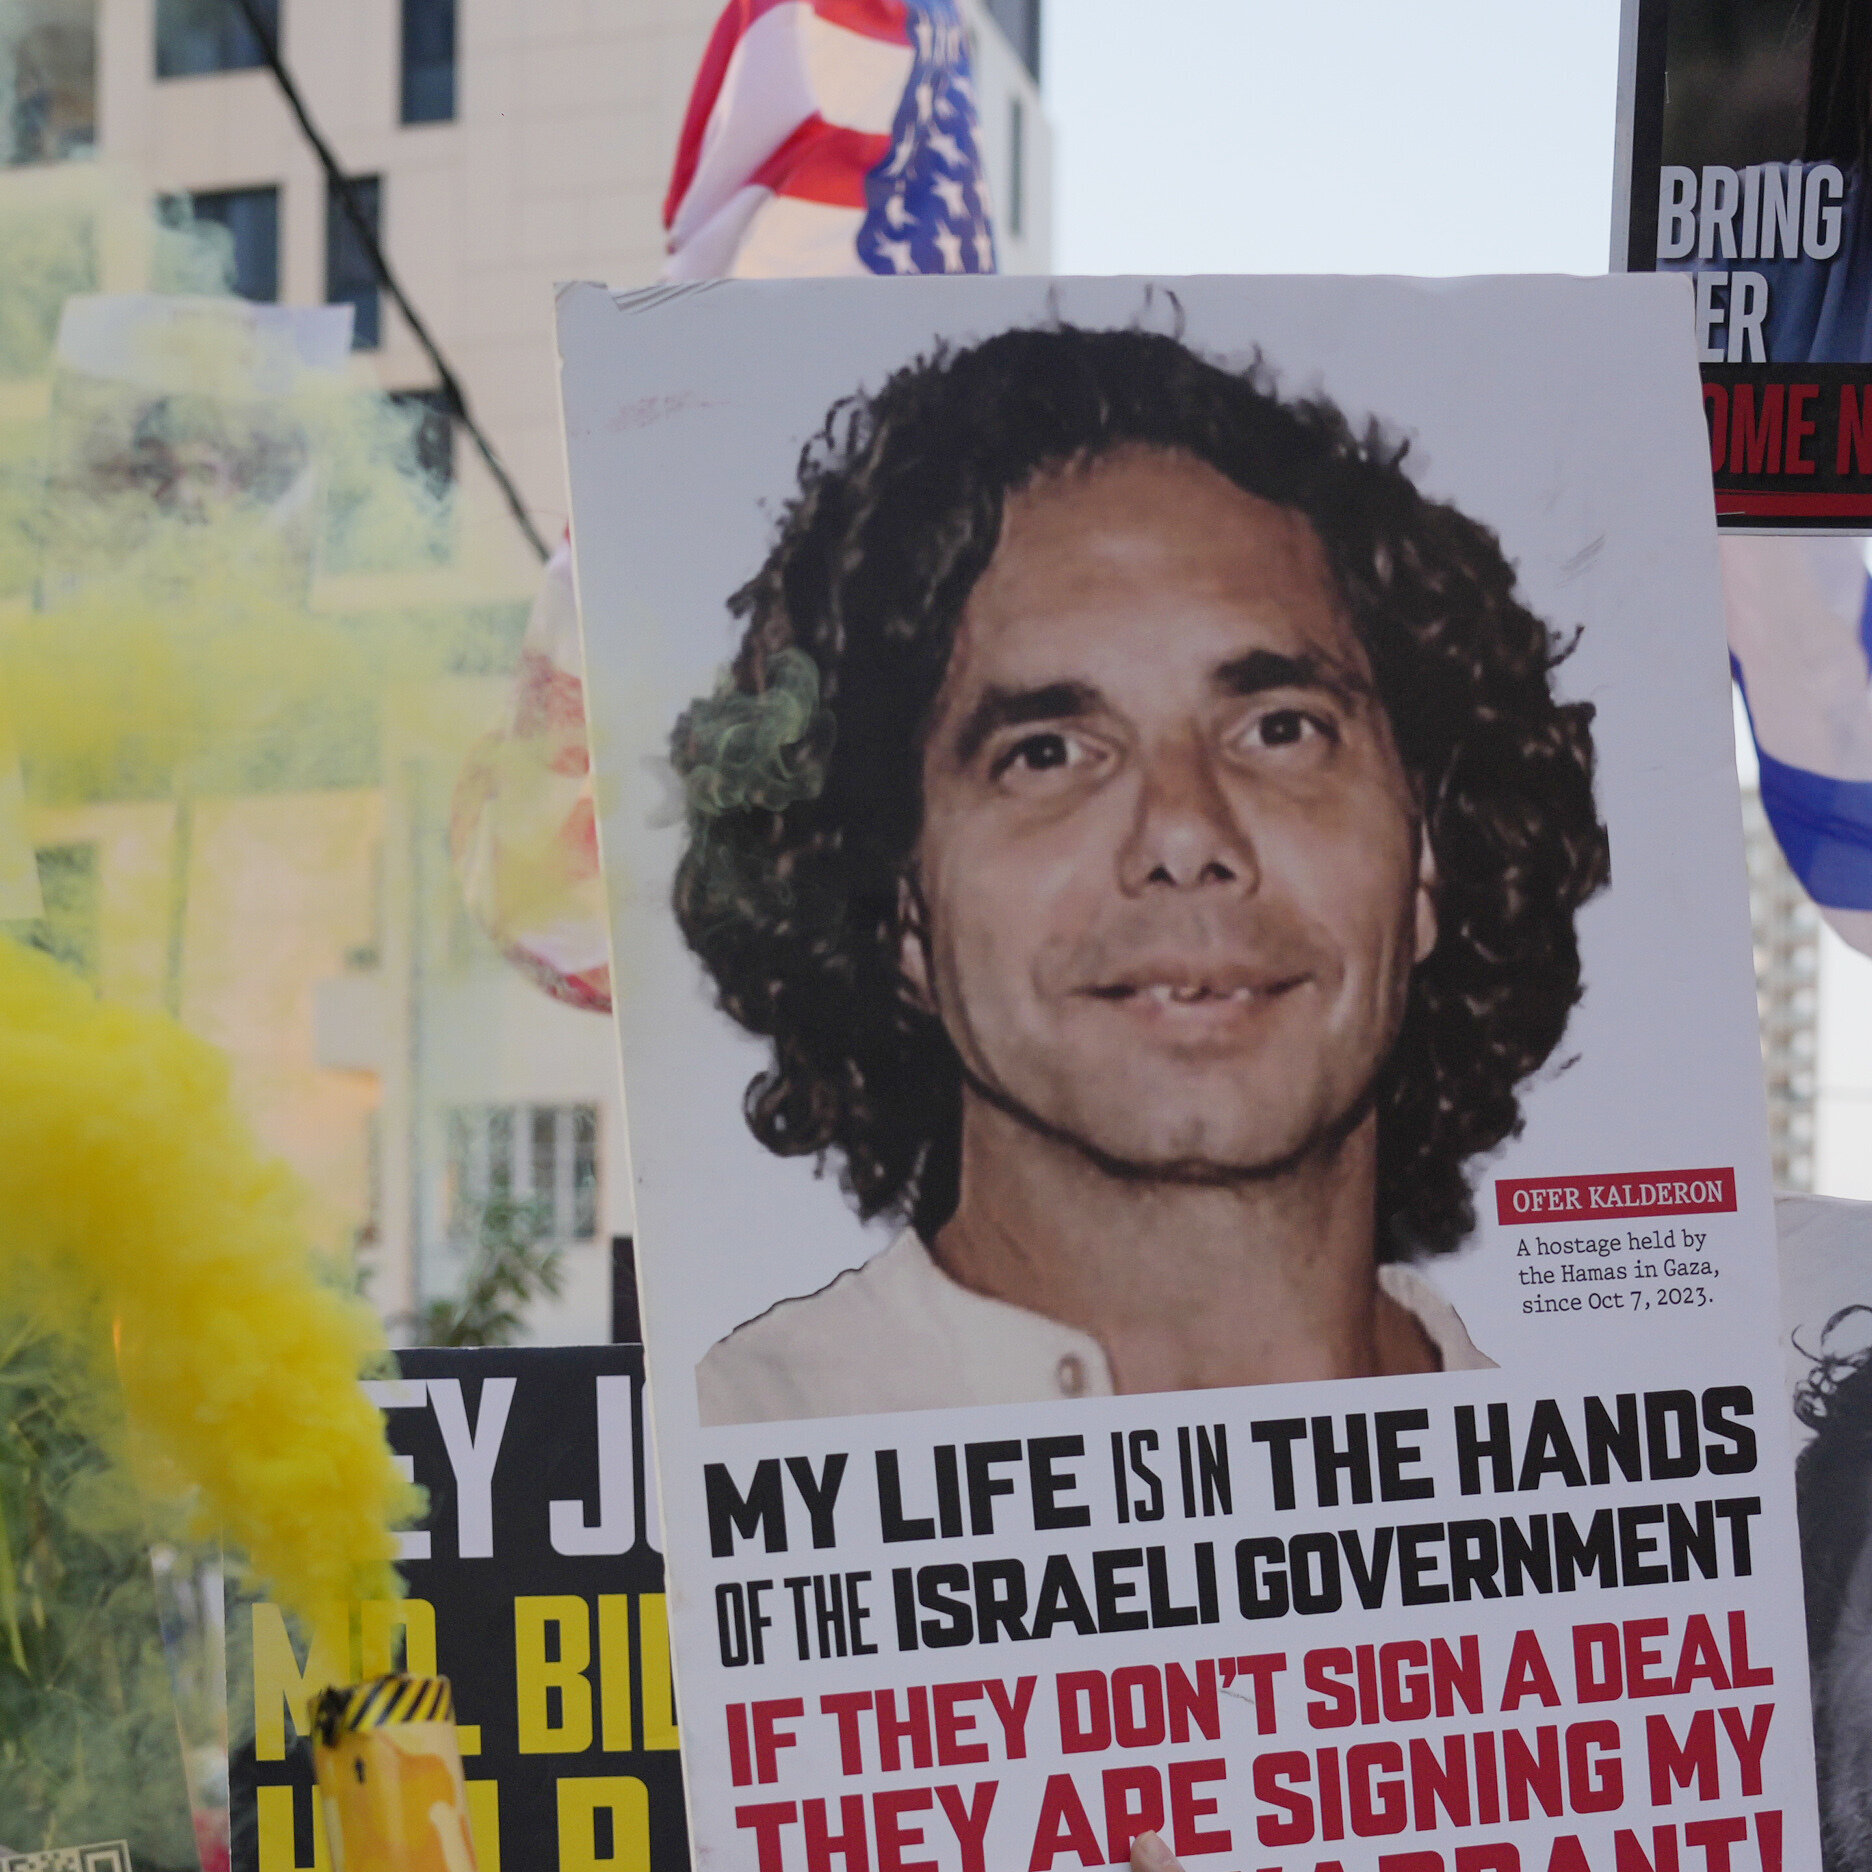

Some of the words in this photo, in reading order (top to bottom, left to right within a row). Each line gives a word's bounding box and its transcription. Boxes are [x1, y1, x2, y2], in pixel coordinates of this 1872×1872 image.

[1656, 163, 1844, 260] BRING
[1692, 271, 1769, 364] ER
[1702, 383, 1820, 475] OME
[1512, 1186, 1583, 1213] OFER
[1588, 1180, 1724, 1209] KALDERON
[1516, 1238, 1531, 1257] A
[1536, 1236, 1621, 1258] hostage
[1627, 1229, 1676, 1251] held
[1681, 1229, 1707, 1251] by
[1518, 1266, 1555, 1285] the
[1561, 1263, 1627, 1283] Hamas
[1634, 1259, 1658, 1279] in
[1663, 1257, 1720, 1279] Gaza,
[1522, 1293, 1582, 1314] since
[1588, 1291, 1625, 1310] Oct
[1630, 1290, 1651, 1311] 7,
[1656, 1286, 1714, 1307] 2023.
[360, 1376, 517, 1560] EY
[549, 1374, 666, 1557] J
[704, 1453, 850, 1558] MY
[876, 1434, 1091, 1544] LIFE
[1113, 1427, 1161, 1525] IS
[1178, 1422, 1233, 1521] IN
[1250, 1408, 1434, 1512] THE
[1456, 1384, 1759, 1497] HANDS
[719, 1580, 772, 1669] OF
[790, 1570, 878, 1662] THE
[891, 1542, 1222, 1652] ISRAELI
[1233, 1496, 1762, 1622] GOVERNMENT
[725, 1697, 805, 1788] IF
[820, 1674, 1038, 1777] THEY
[1056, 1651, 1288, 1755] DON'T
[1304, 1631, 1485, 1730] SIGN
[1499, 1628, 1560, 1712] A
[1571, 1609, 1773, 1705] DEAL
[1252, 1718, 1625, 1849] SIGNING
[1645, 1702, 1776, 1806] MY
